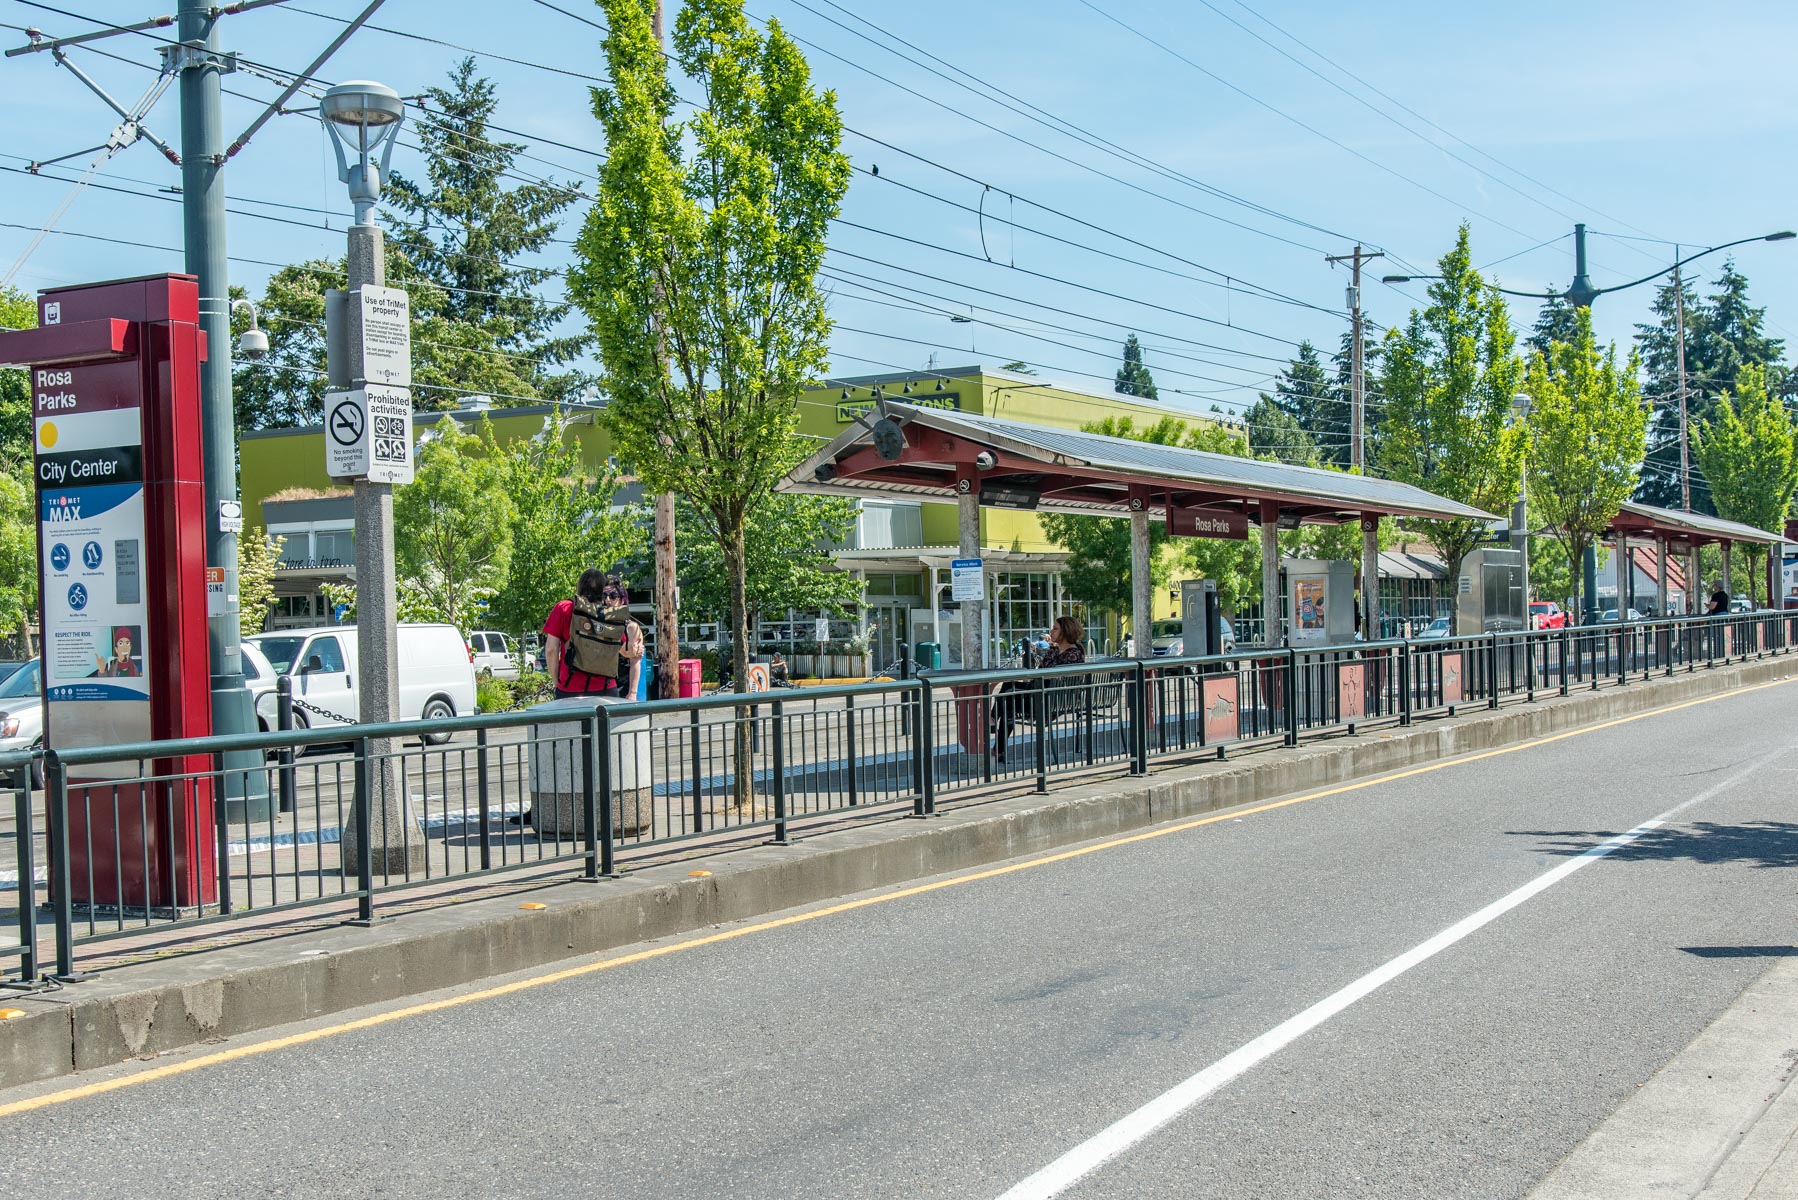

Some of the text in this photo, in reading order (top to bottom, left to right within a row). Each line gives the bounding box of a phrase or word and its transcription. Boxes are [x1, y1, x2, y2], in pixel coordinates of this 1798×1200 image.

[365, 296, 377, 304] Use
[387, 300, 406, 309] TriMet
[373, 306, 399, 317] property
[37, 370, 72, 387] Rosa
[38, 391, 76, 410] Parks
[368, 393, 409, 406] Prohibited
[371, 405, 407, 416] activities
[840, 404, 873, 419] NEW
[40, 459, 117, 483] City Center
[50, 506, 81, 522] MAX
[1196, 517, 1230, 533] Rosa Parks
[307, 556, 315, 566] in
[320, 555, 341, 566] town
